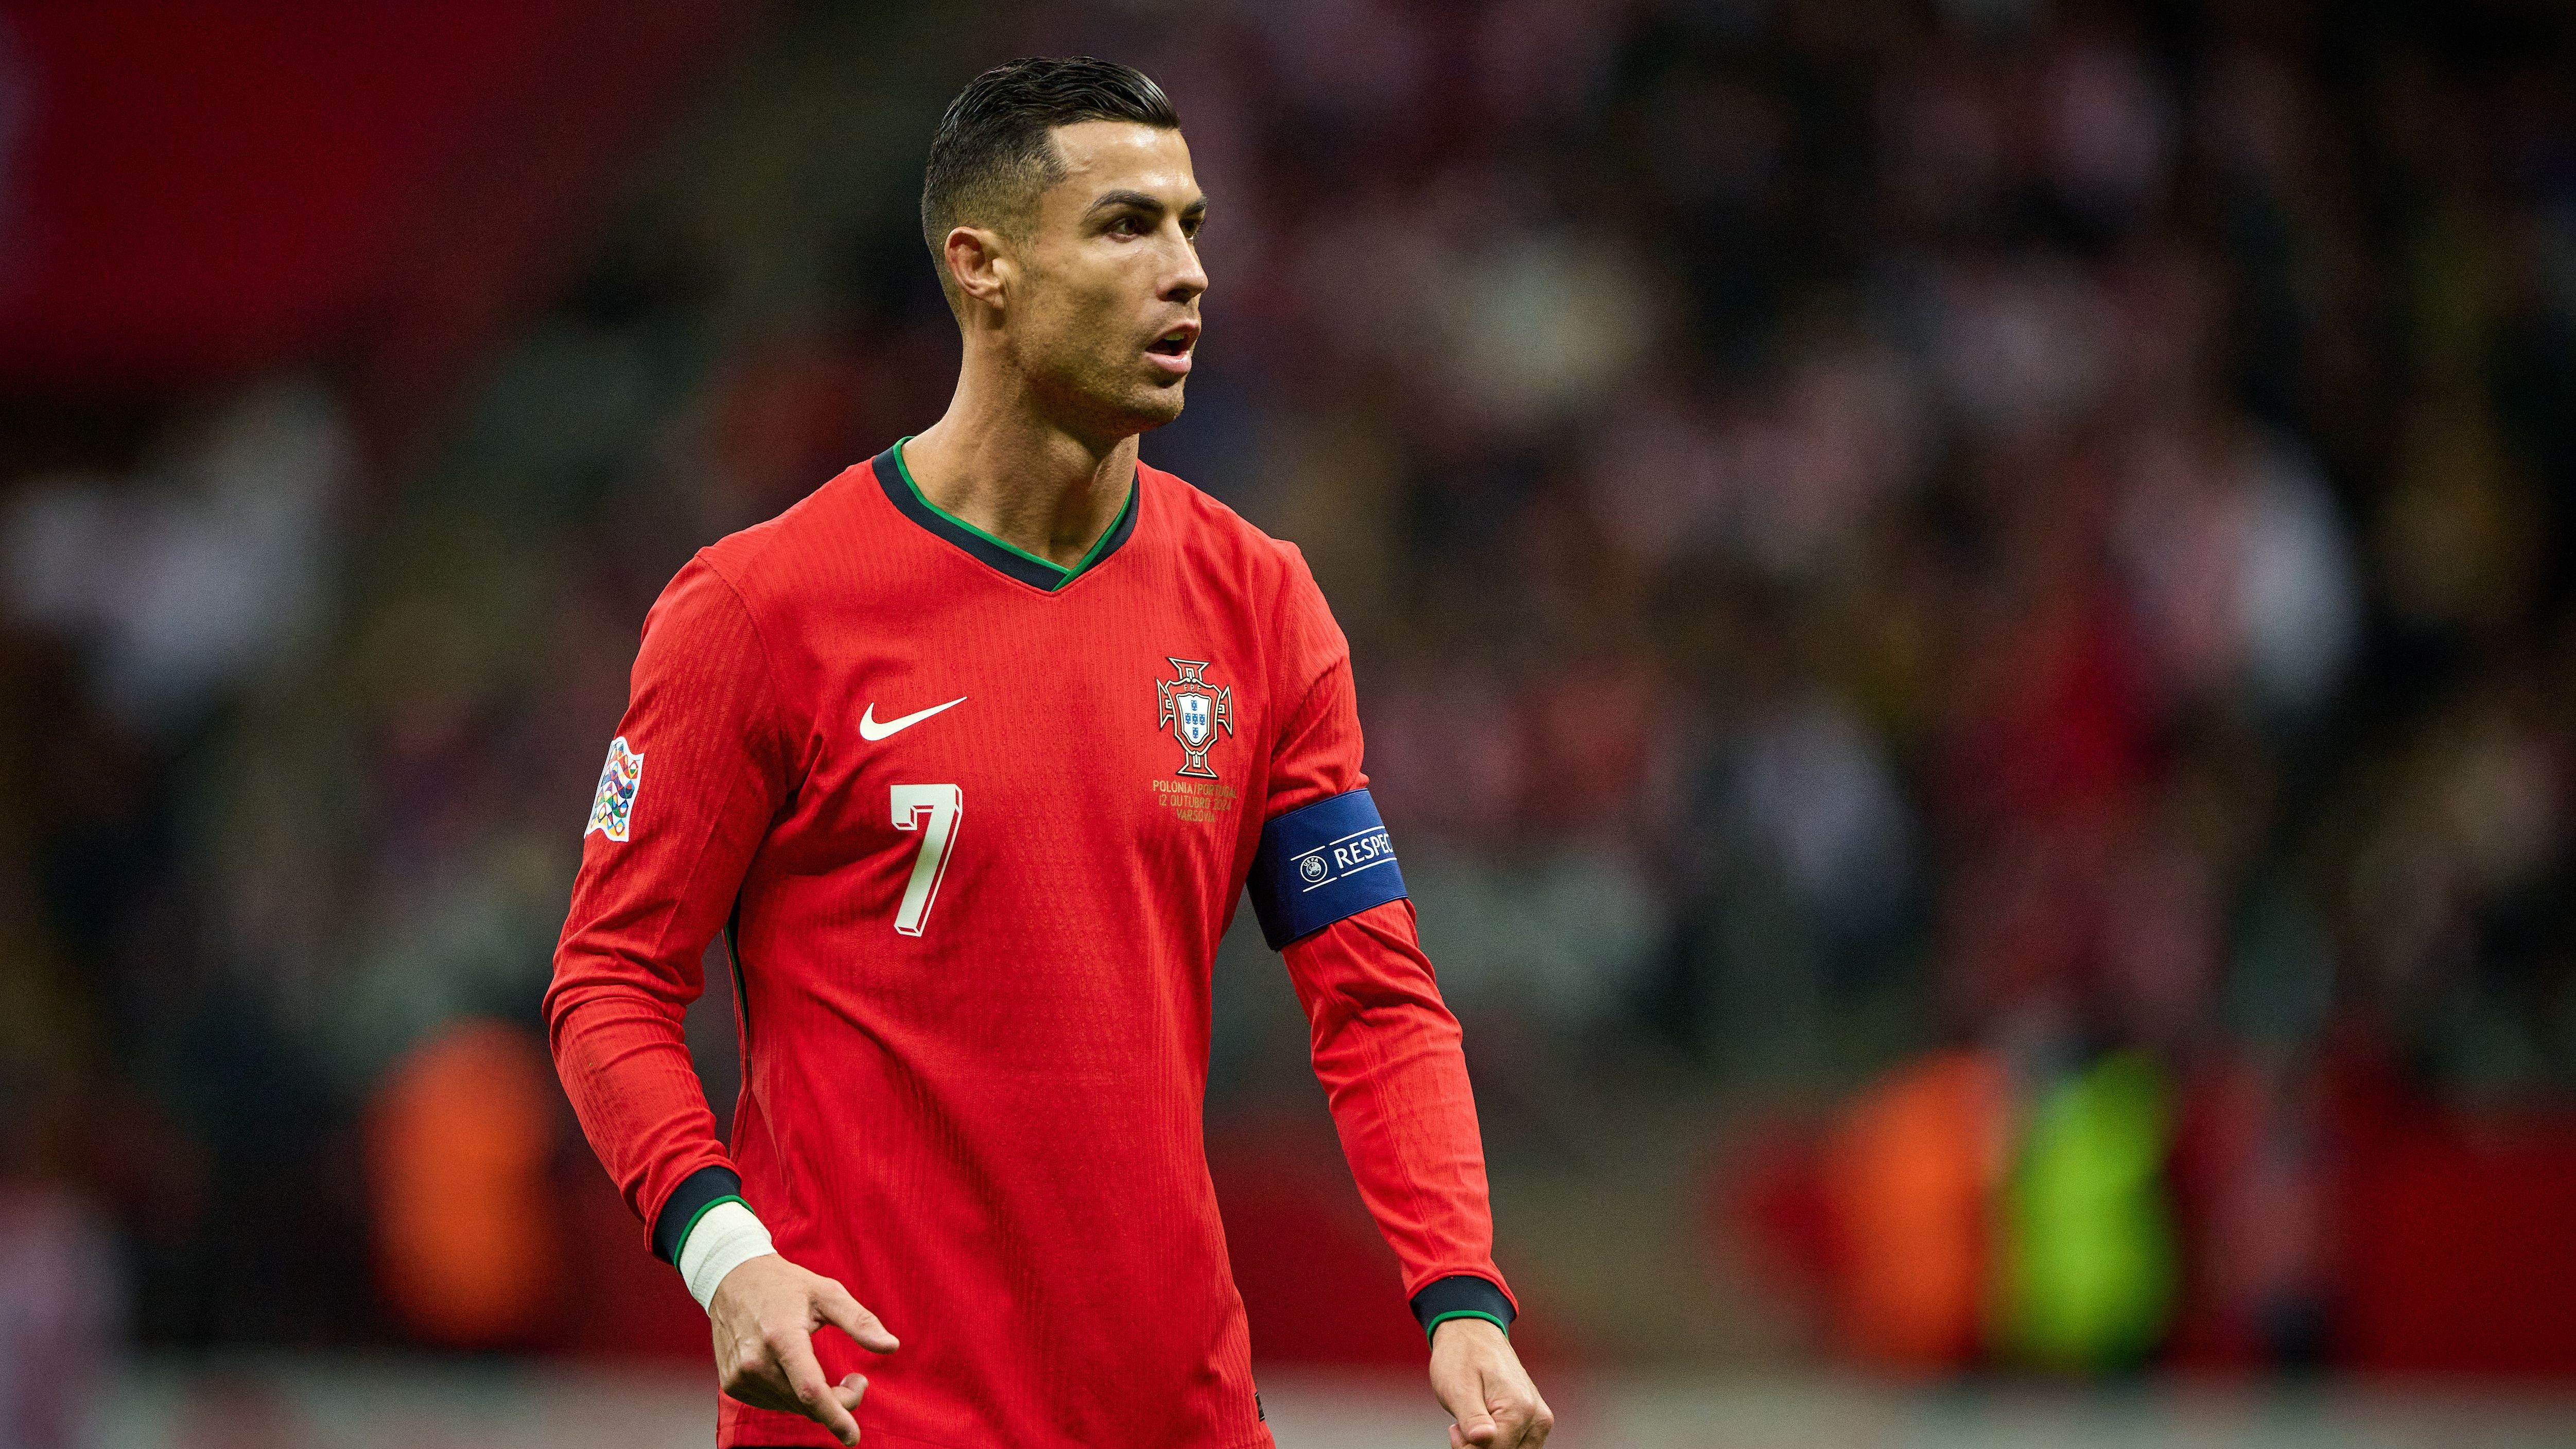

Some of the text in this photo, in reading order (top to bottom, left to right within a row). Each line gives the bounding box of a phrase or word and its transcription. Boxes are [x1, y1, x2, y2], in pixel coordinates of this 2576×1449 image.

[1159, 794, 1231, 810] 12 OUTUBRO 2024
[890, 783, 963, 937] 7
[1303, 858, 1318, 866] UEFA
